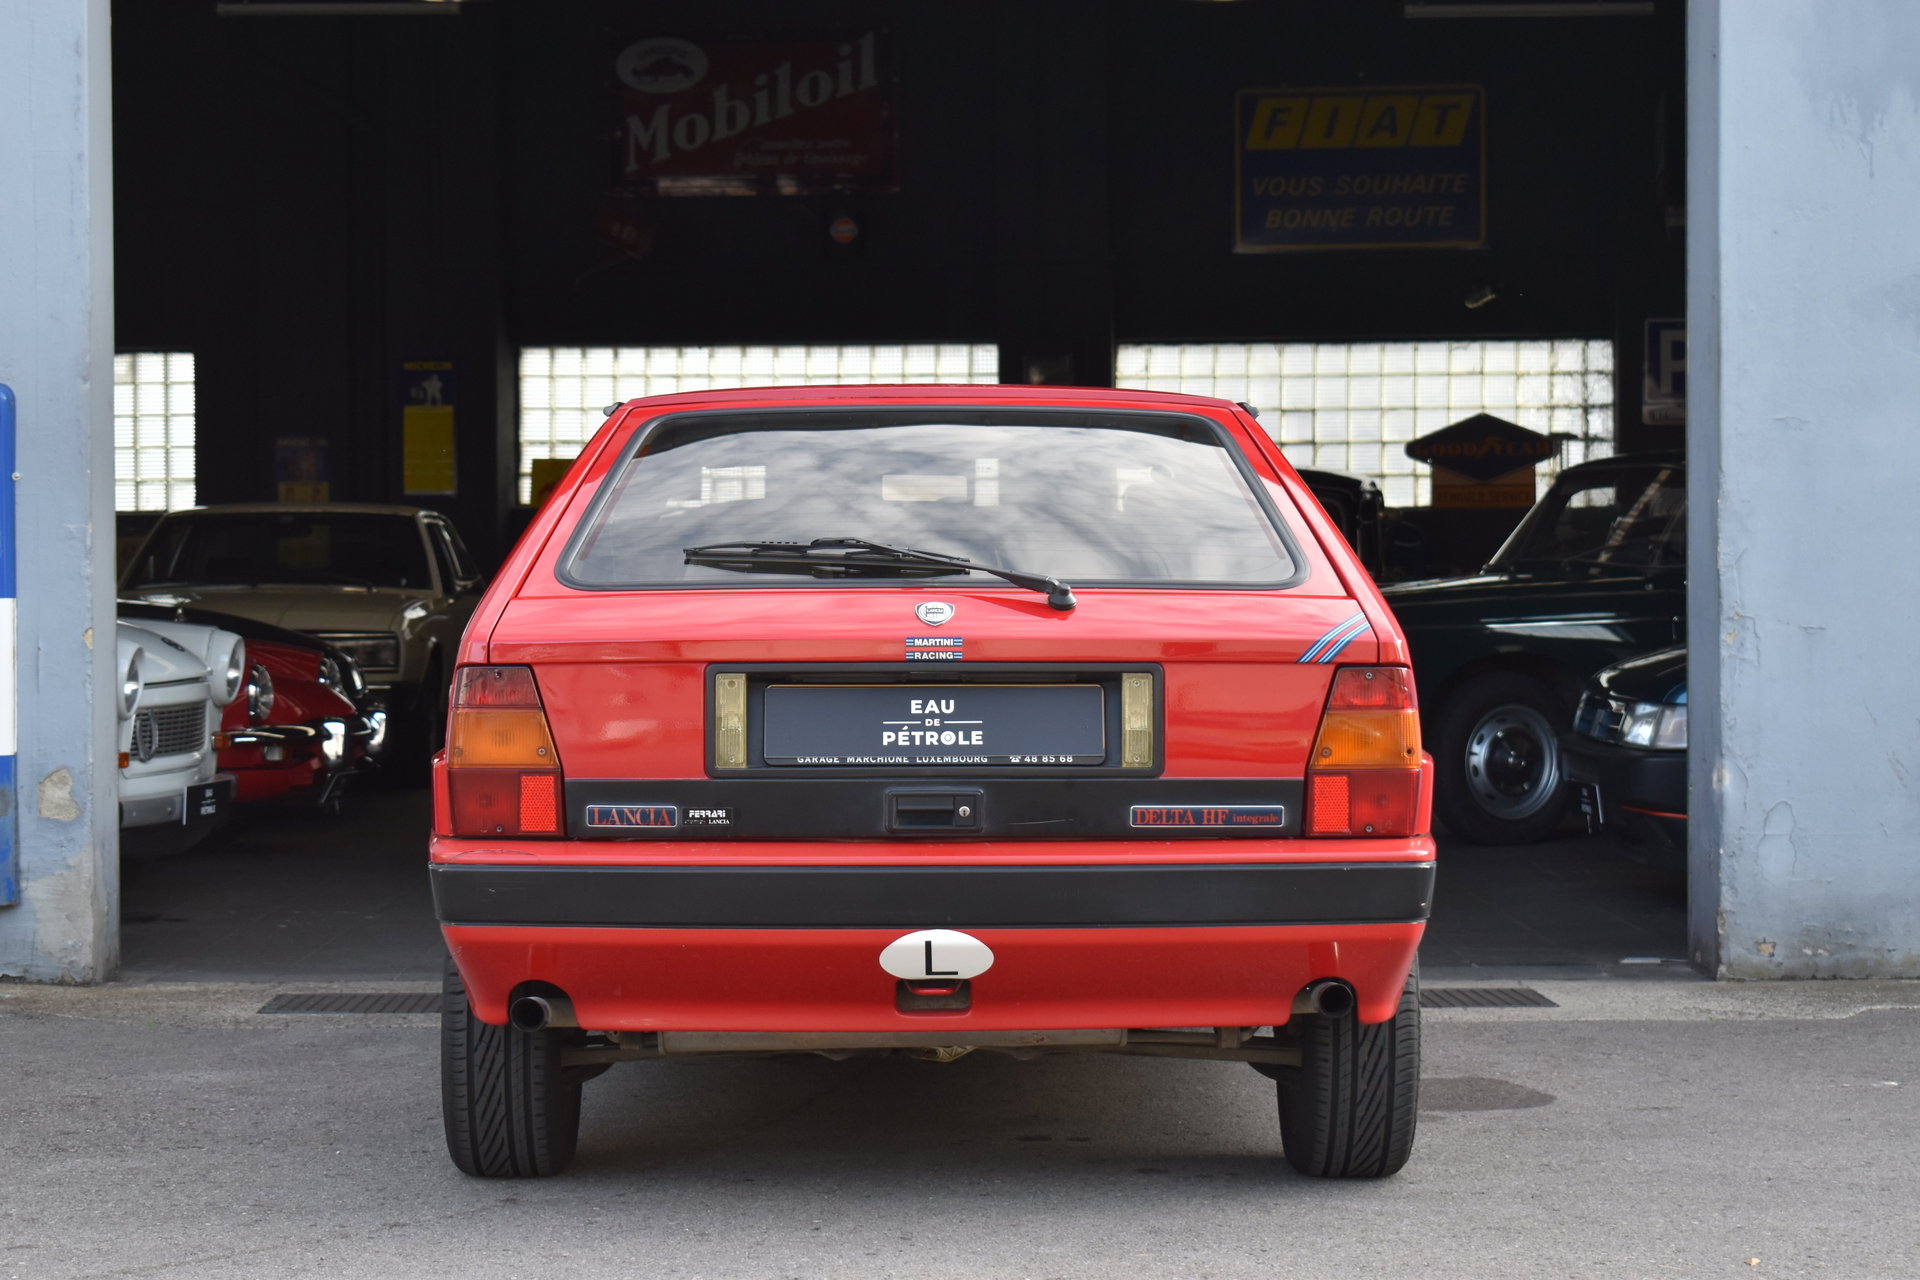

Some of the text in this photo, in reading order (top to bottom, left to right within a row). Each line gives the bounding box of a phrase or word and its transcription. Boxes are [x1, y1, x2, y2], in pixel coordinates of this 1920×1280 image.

[625, 31, 878, 173] Mobiloil
[1263, 103, 1461, 141] FIAT
[1253, 173, 1469, 197] VOUS SOUHAITE
[1265, 206, 1455, 229] BONNE ROUTE
[914, 638, 954, 646] MARTINI
[910, 699, 955, 714] EAU
[925, 718, 941, 726] DE
[882, 725, 984, 746] PÉTROLE
[1024, 755, 1038, 763] 48
[1042, 755, 1056, 763] 85
[1059, 755, 1073, 763] 68
[592, 807, 672, 826] LANCIA
[1135, 808, 1279, 825] DELTA HF integrale
[925, 940, 958, 975] L
